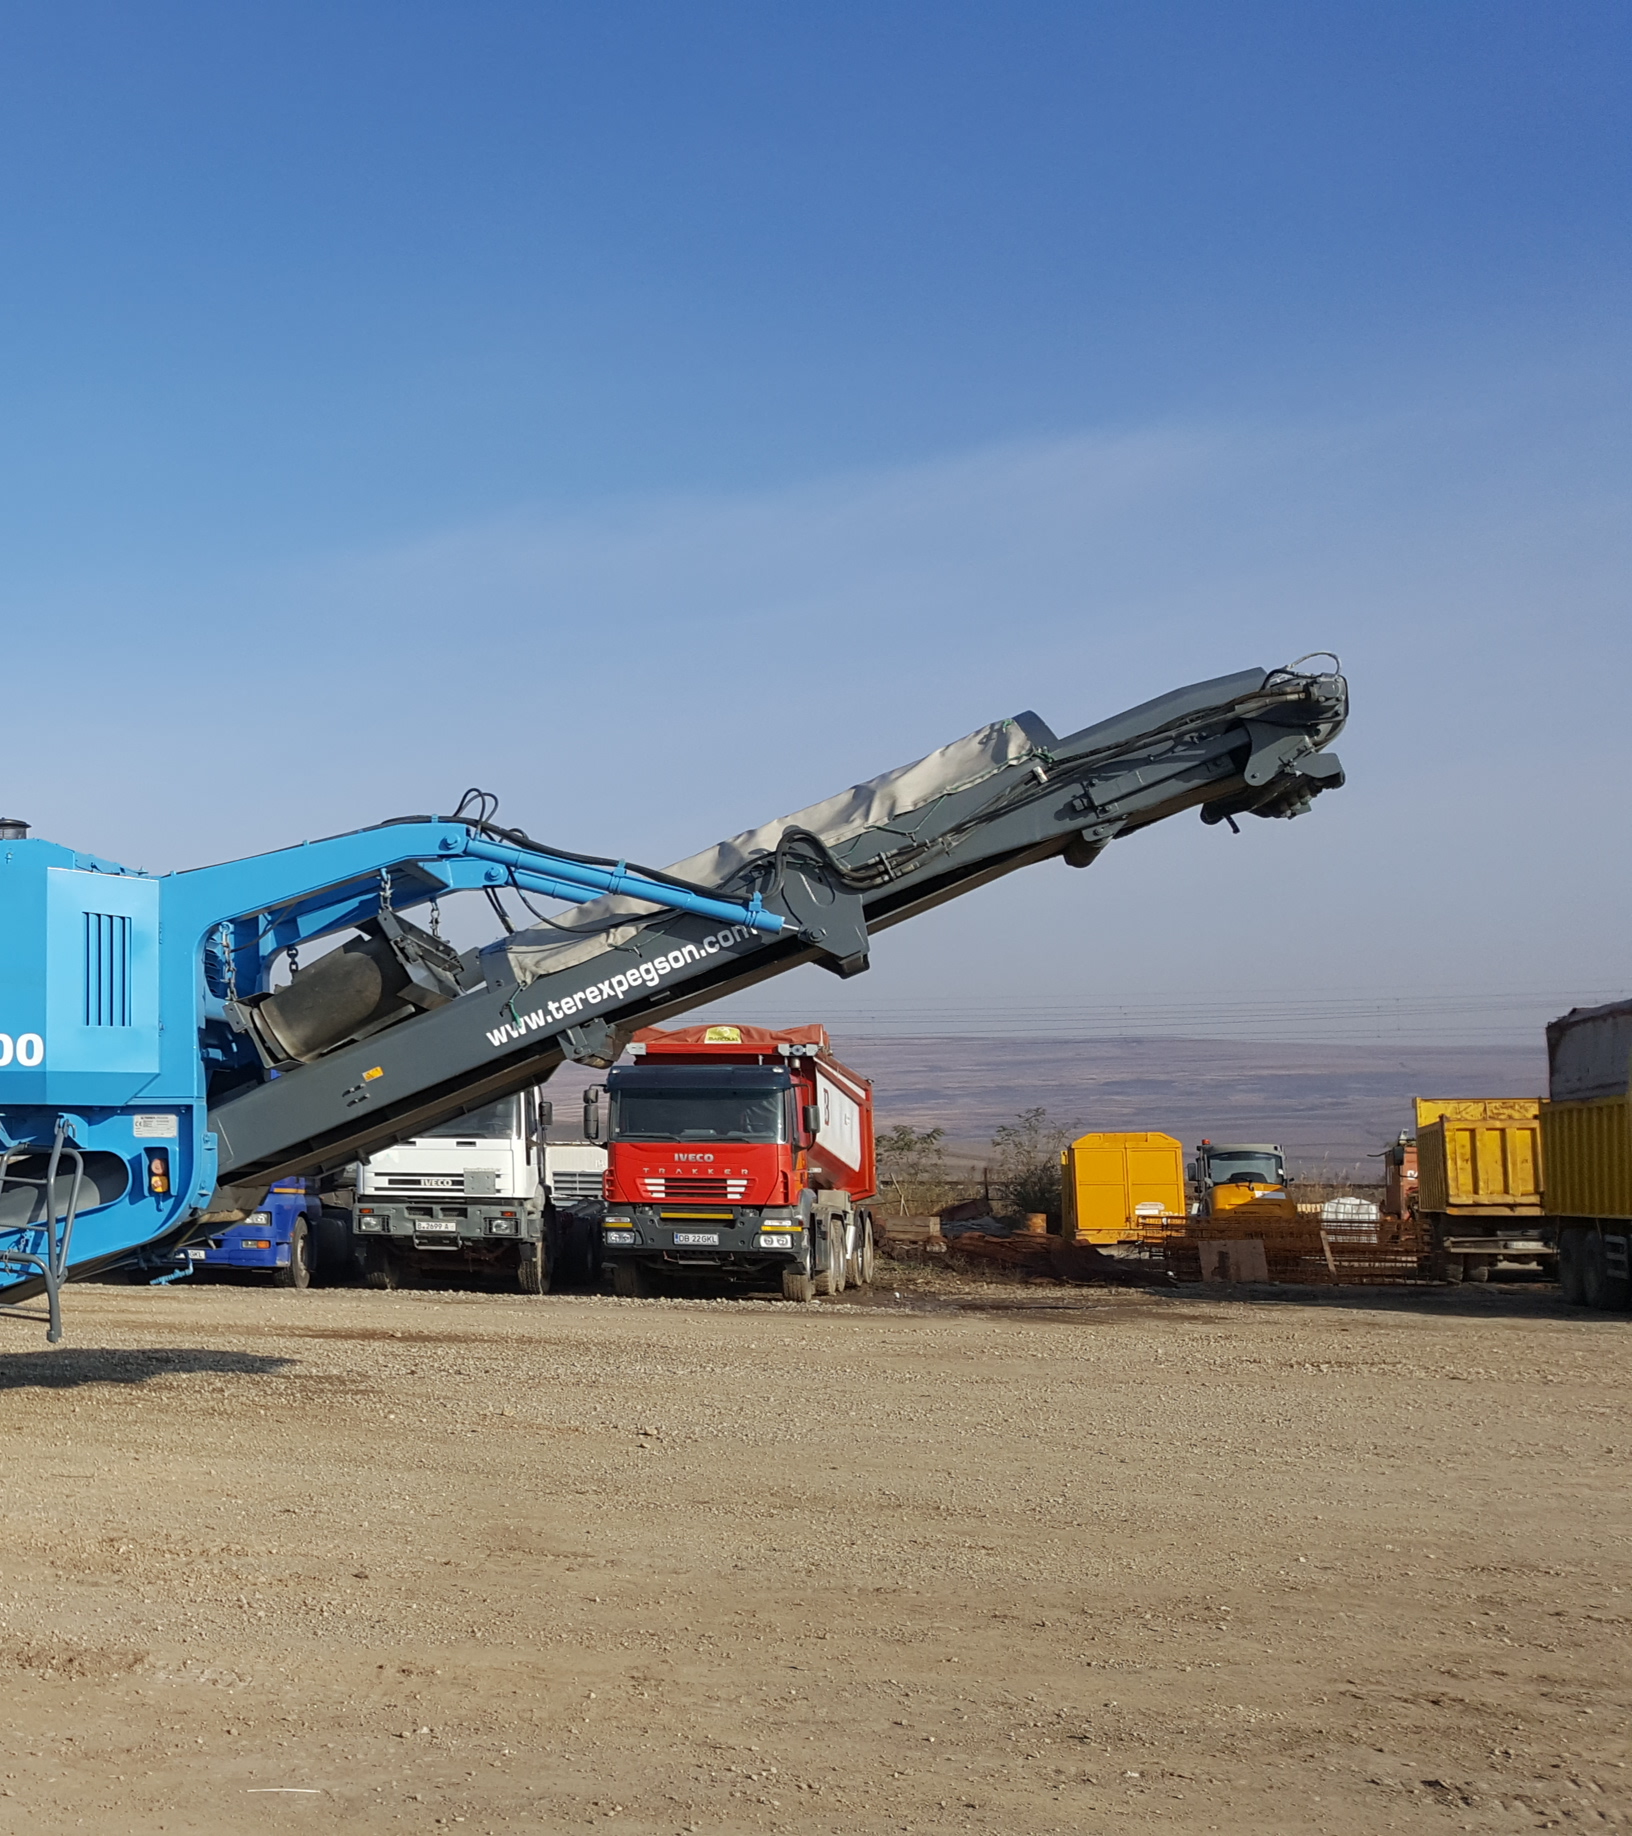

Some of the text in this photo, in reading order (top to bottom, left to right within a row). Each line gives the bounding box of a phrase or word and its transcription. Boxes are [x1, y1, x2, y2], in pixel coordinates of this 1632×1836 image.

[485, 924, 759, 1047] www.terexpegson.com
[674, 1153, 715, 1163] IVECO
[643, 1167, 749, 1176] TRAKKER
[420, 1179, 453, 1187] IVECO
